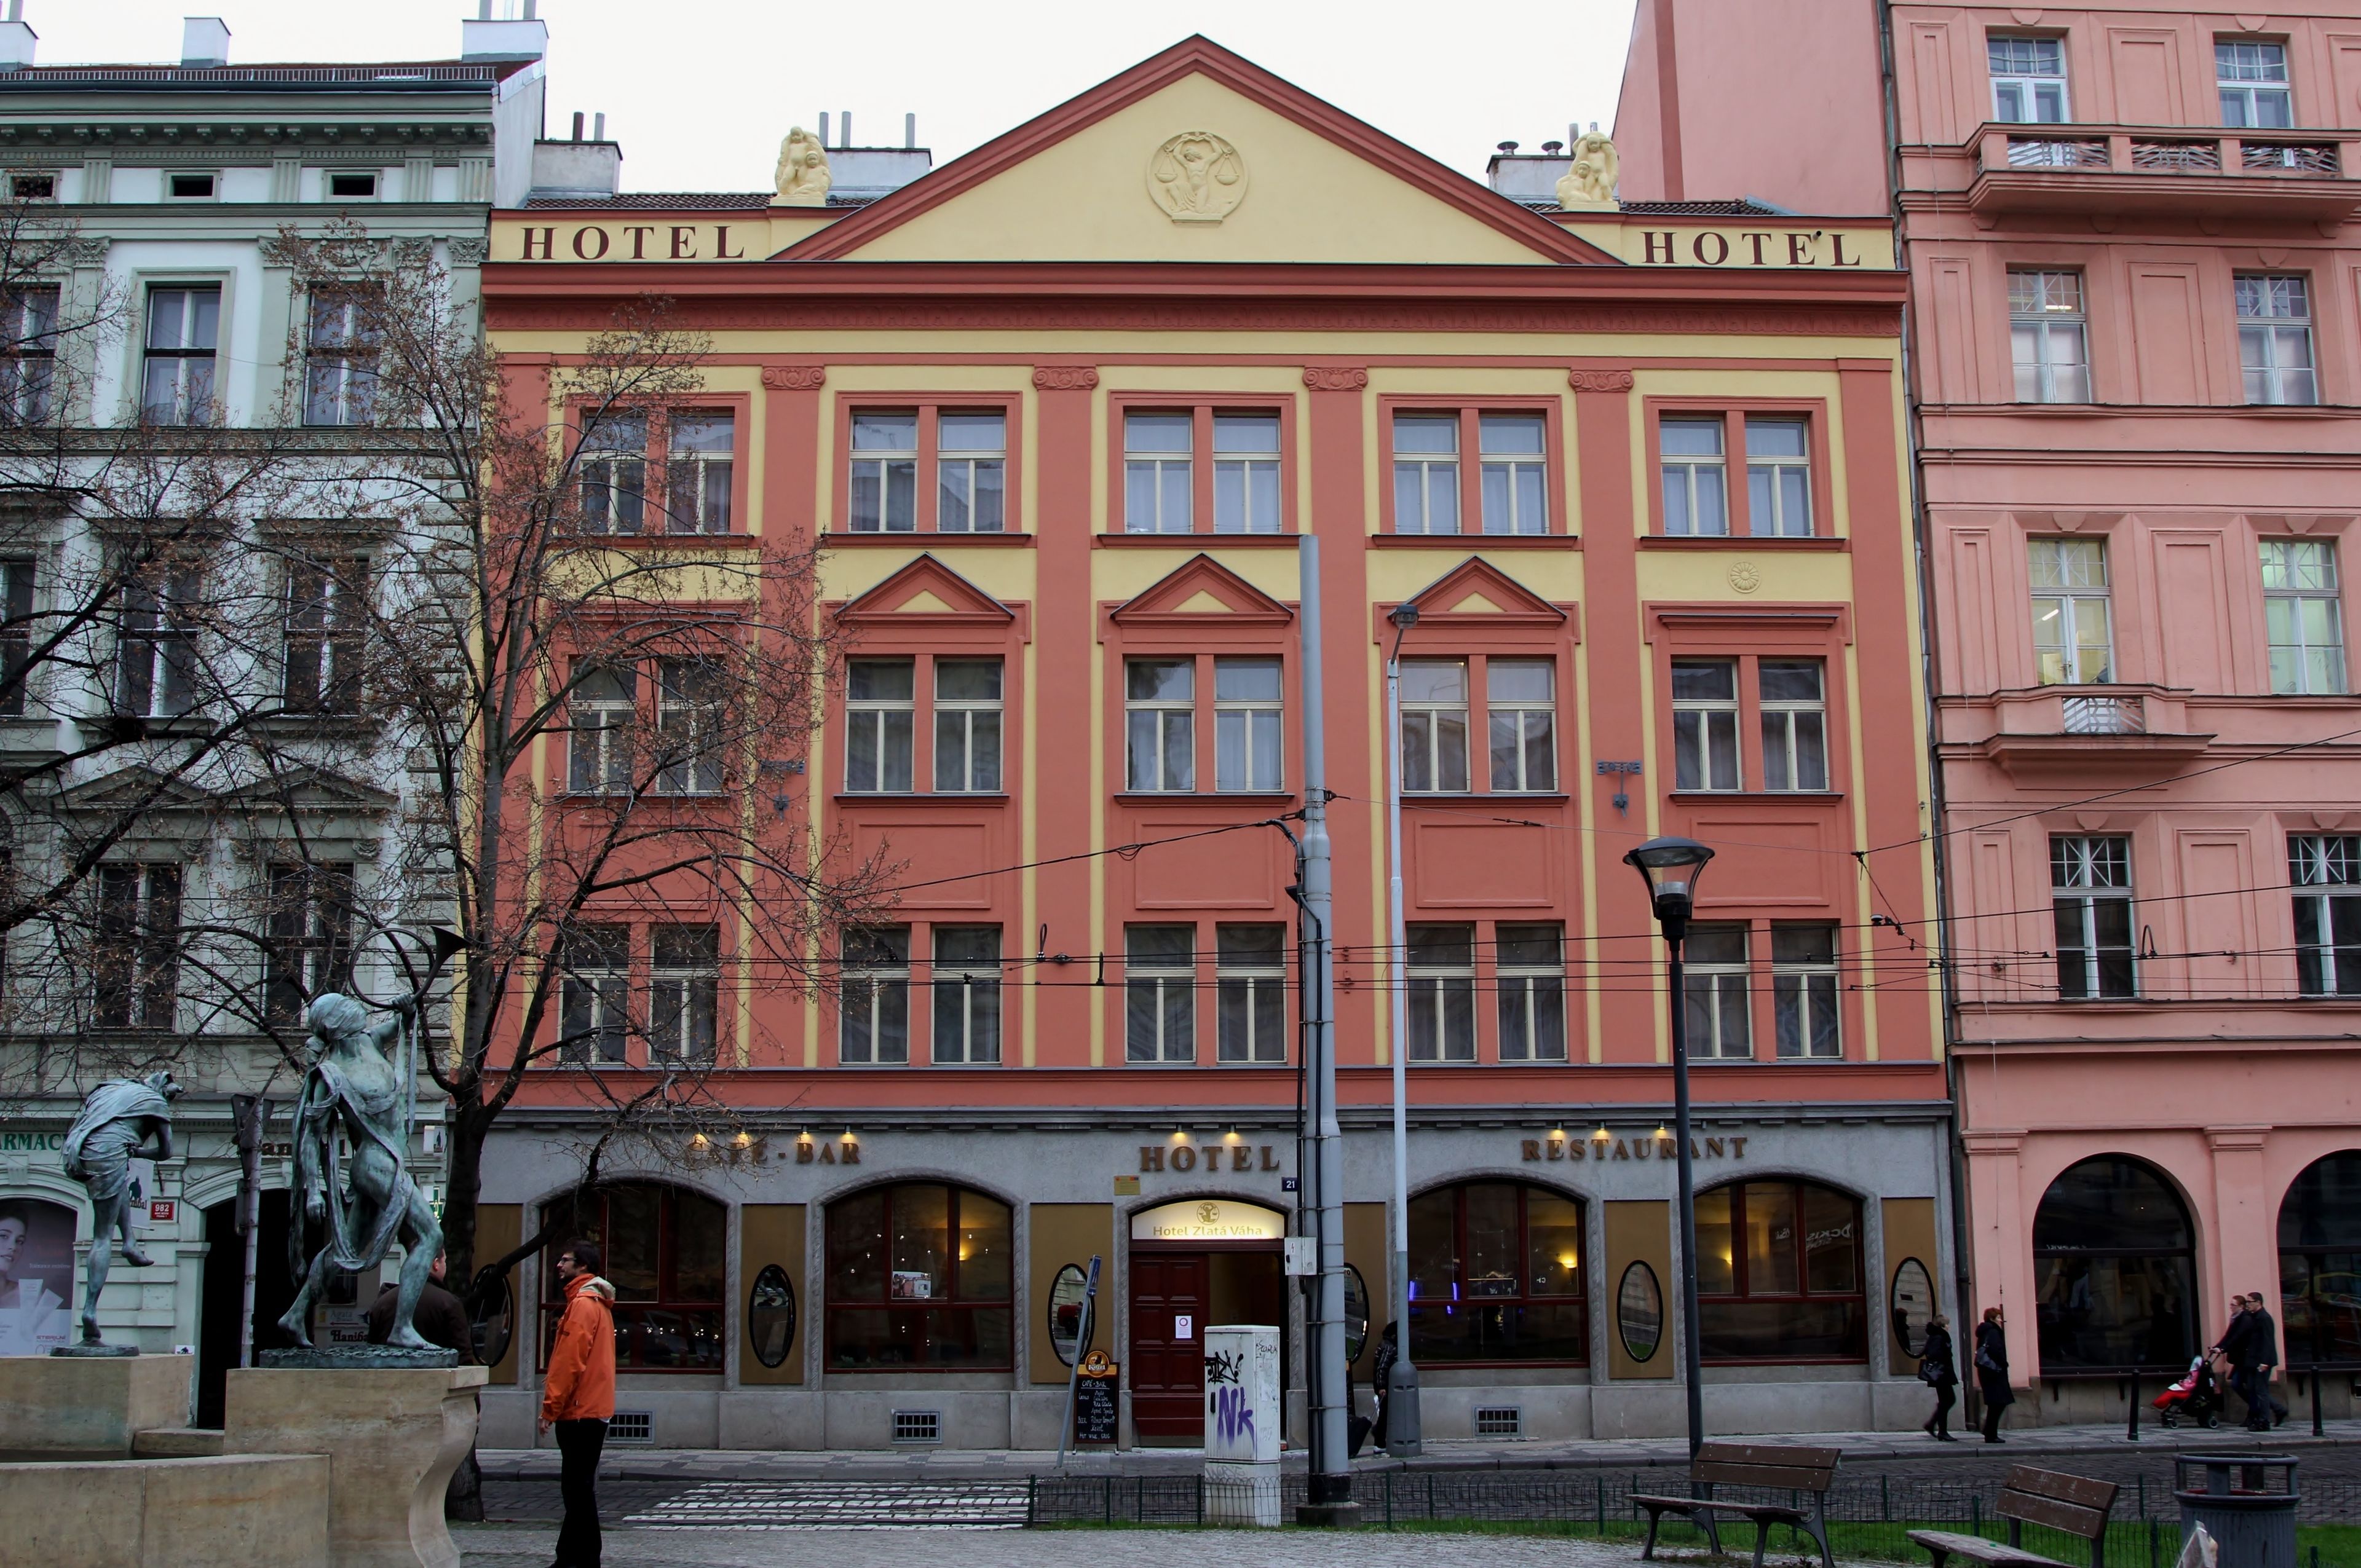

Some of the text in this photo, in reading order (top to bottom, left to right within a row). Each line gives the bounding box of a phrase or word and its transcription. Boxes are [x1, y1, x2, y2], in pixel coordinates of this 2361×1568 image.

[518, 226, 745, 260] HOTEL
[1640, 231, 1861, 266] HOTEL
[0, 1133, 69, 1151] RMAC
[1521, 1137, 1748, 1160] RESTAURANT
[1139, 1146, 1280, 1172] HOTEL
[155, 1204, 169, 1212] 982
[1153, 1225, 1262, 1236] Hotel Zlatá Váha
